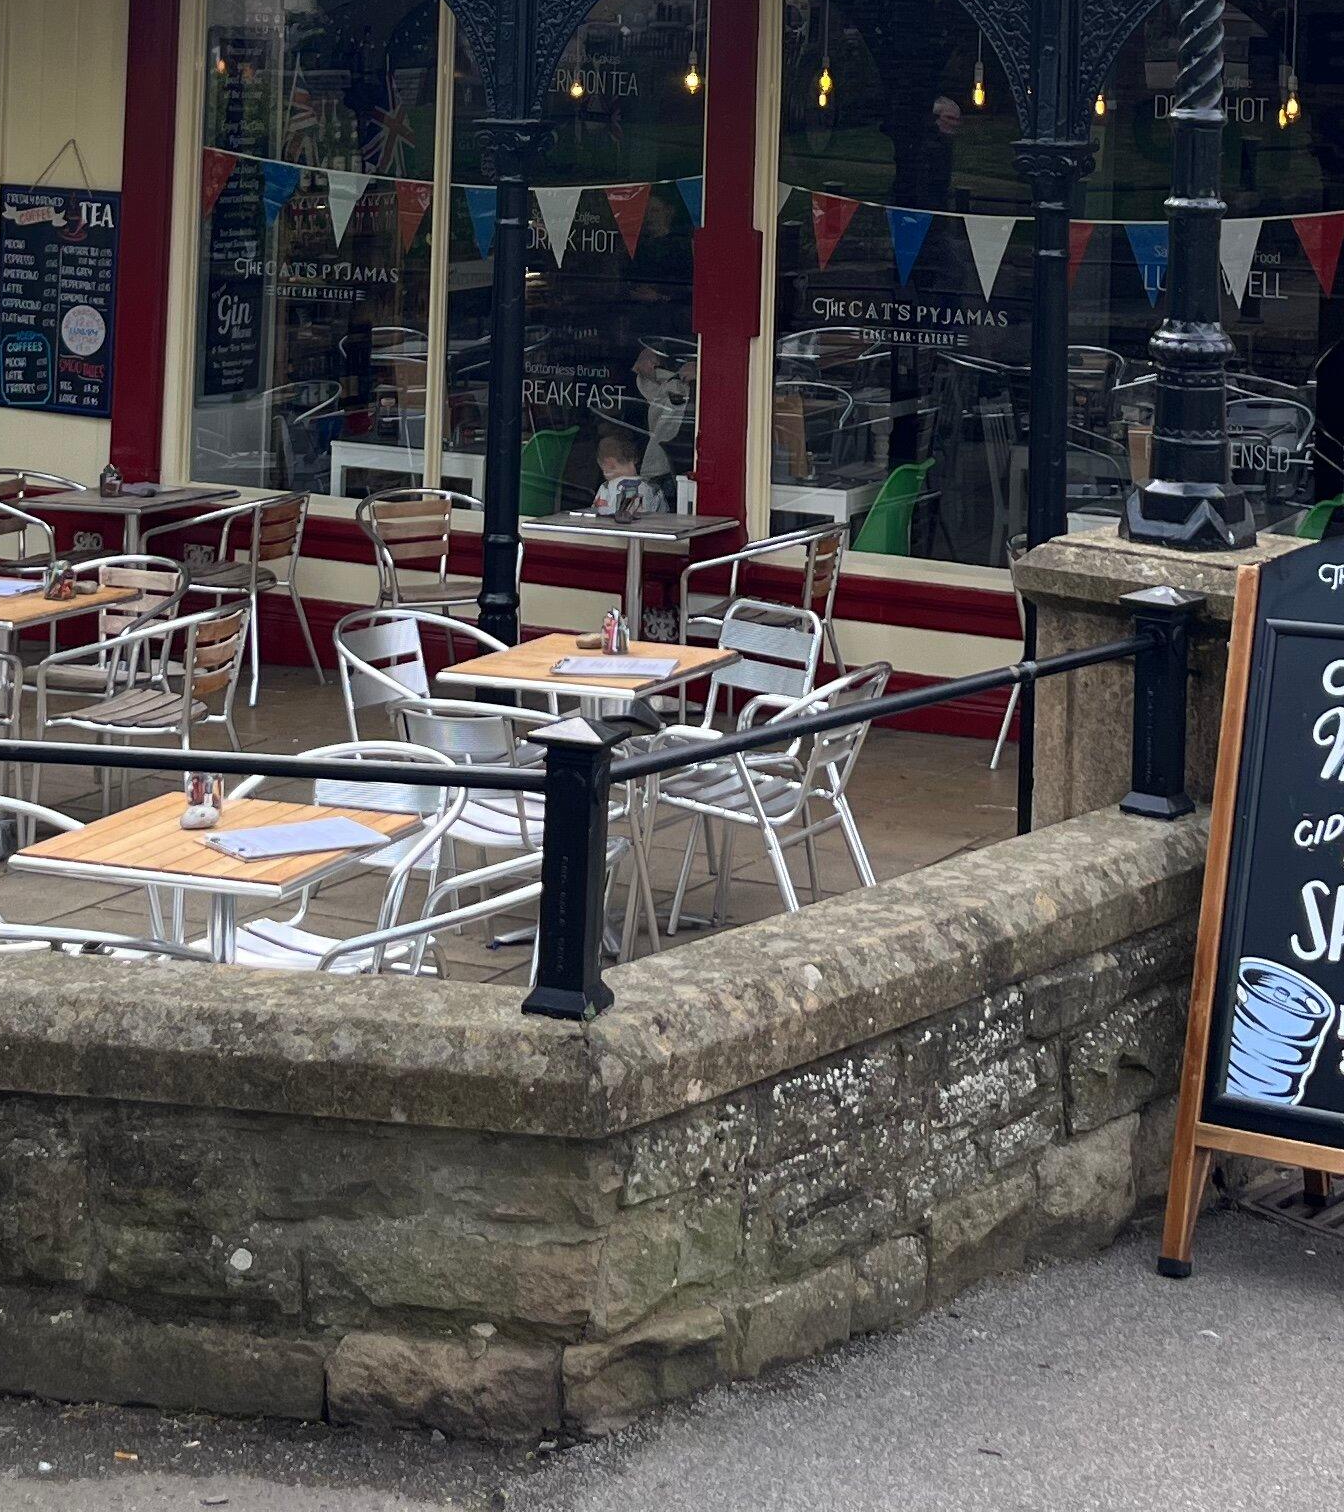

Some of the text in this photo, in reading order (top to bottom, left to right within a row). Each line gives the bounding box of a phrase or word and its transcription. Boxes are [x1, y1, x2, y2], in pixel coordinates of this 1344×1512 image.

[611, 72, 639, 96] TEA
[1224, 96, 1270, 123] HOT
[79, 201, 115, 228] TEA
[582, 230, 619, 253] HOT
[322, 262, 399, 283] PYJAMAS
[217, 295, 252, 335] Gin
[849, 301, 911, 322] CAT'S
[916, 305, 1008, 327] PYJAMAS
[6, 341, 44, 352] COFFEES
[525, 361, 610, 378] Bottomless Brunch
[522, 379, 626, 410] REAKFAST
[1230, 442, 1290, 473] ENSED
